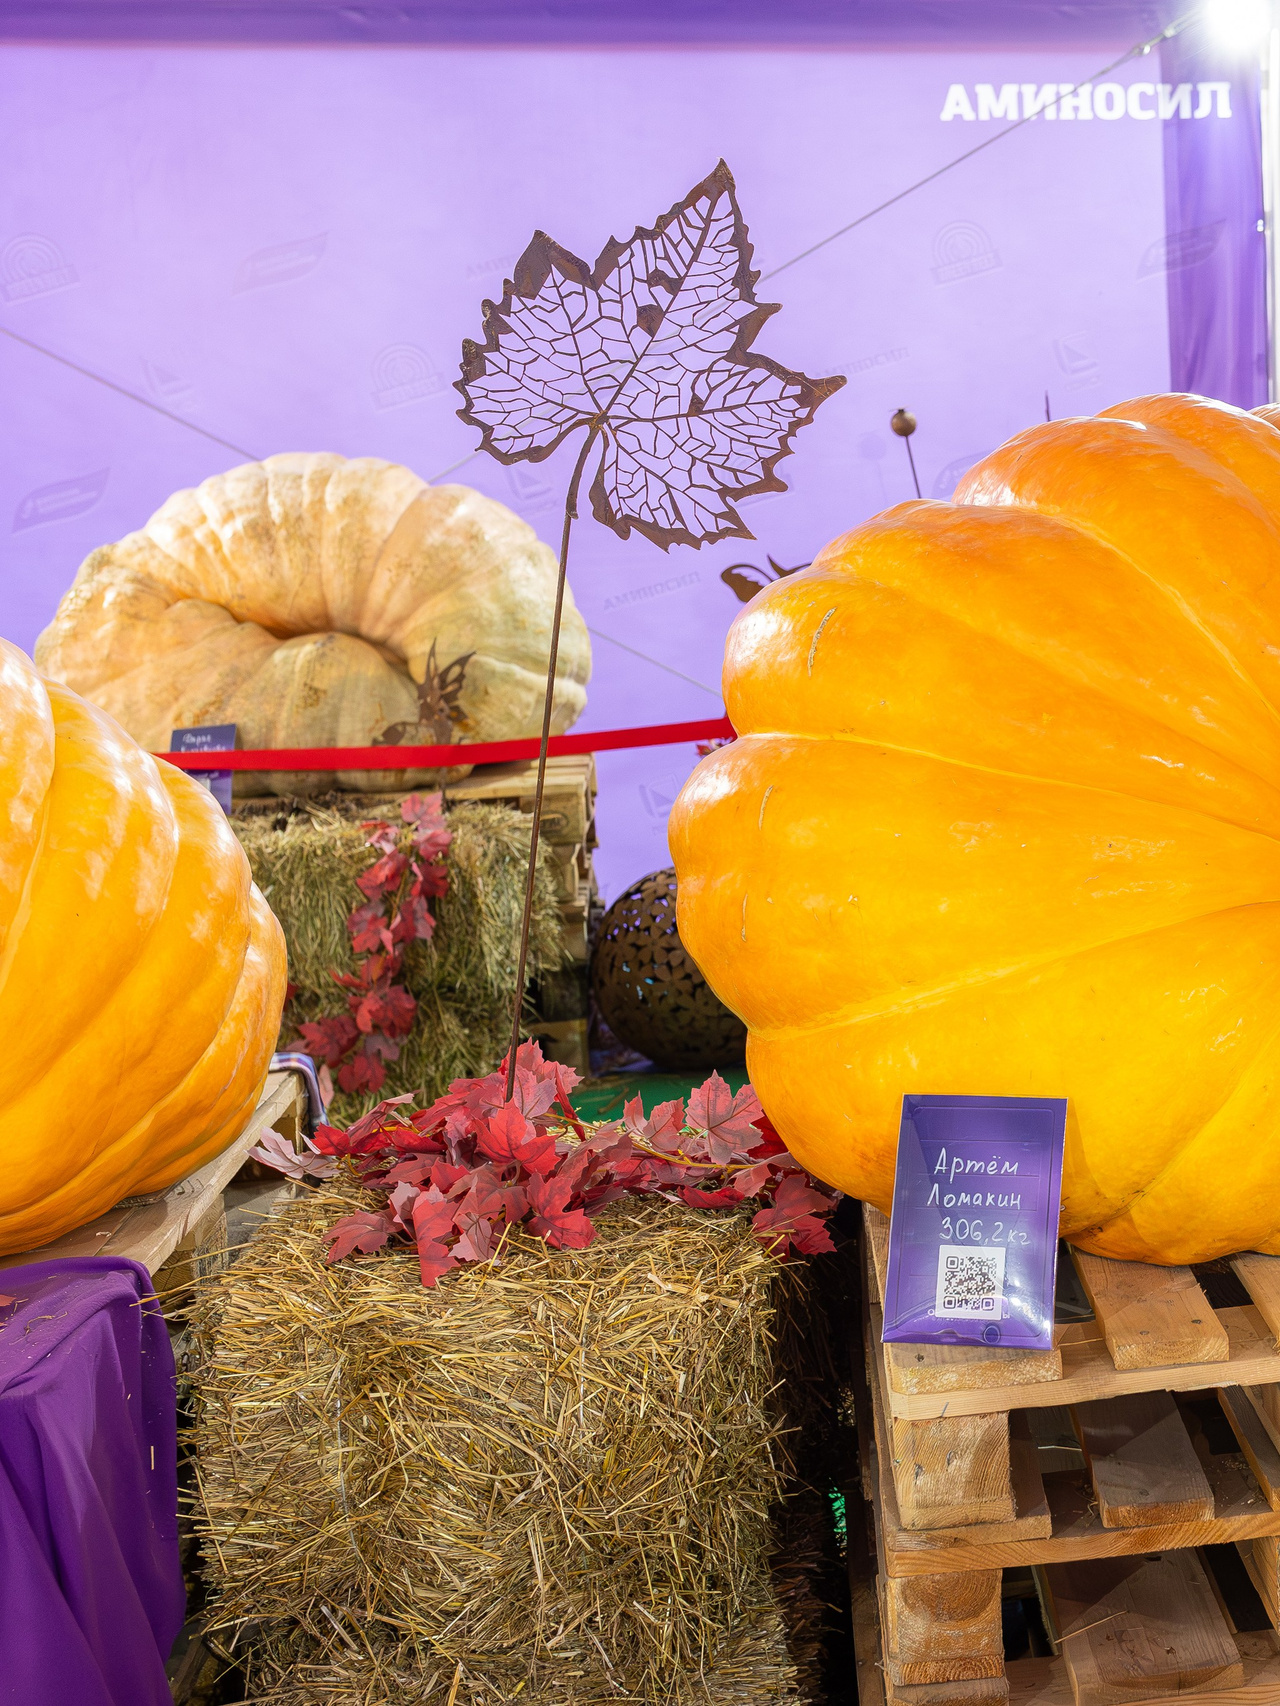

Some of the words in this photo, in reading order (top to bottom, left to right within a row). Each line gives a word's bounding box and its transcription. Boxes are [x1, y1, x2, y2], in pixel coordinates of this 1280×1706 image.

[940, 82, 1232, 121] АМИНОСИЛ
[934, 1147, 1019, 1184] Артём
[926, 1183, 1021, 1210] Ломакин
